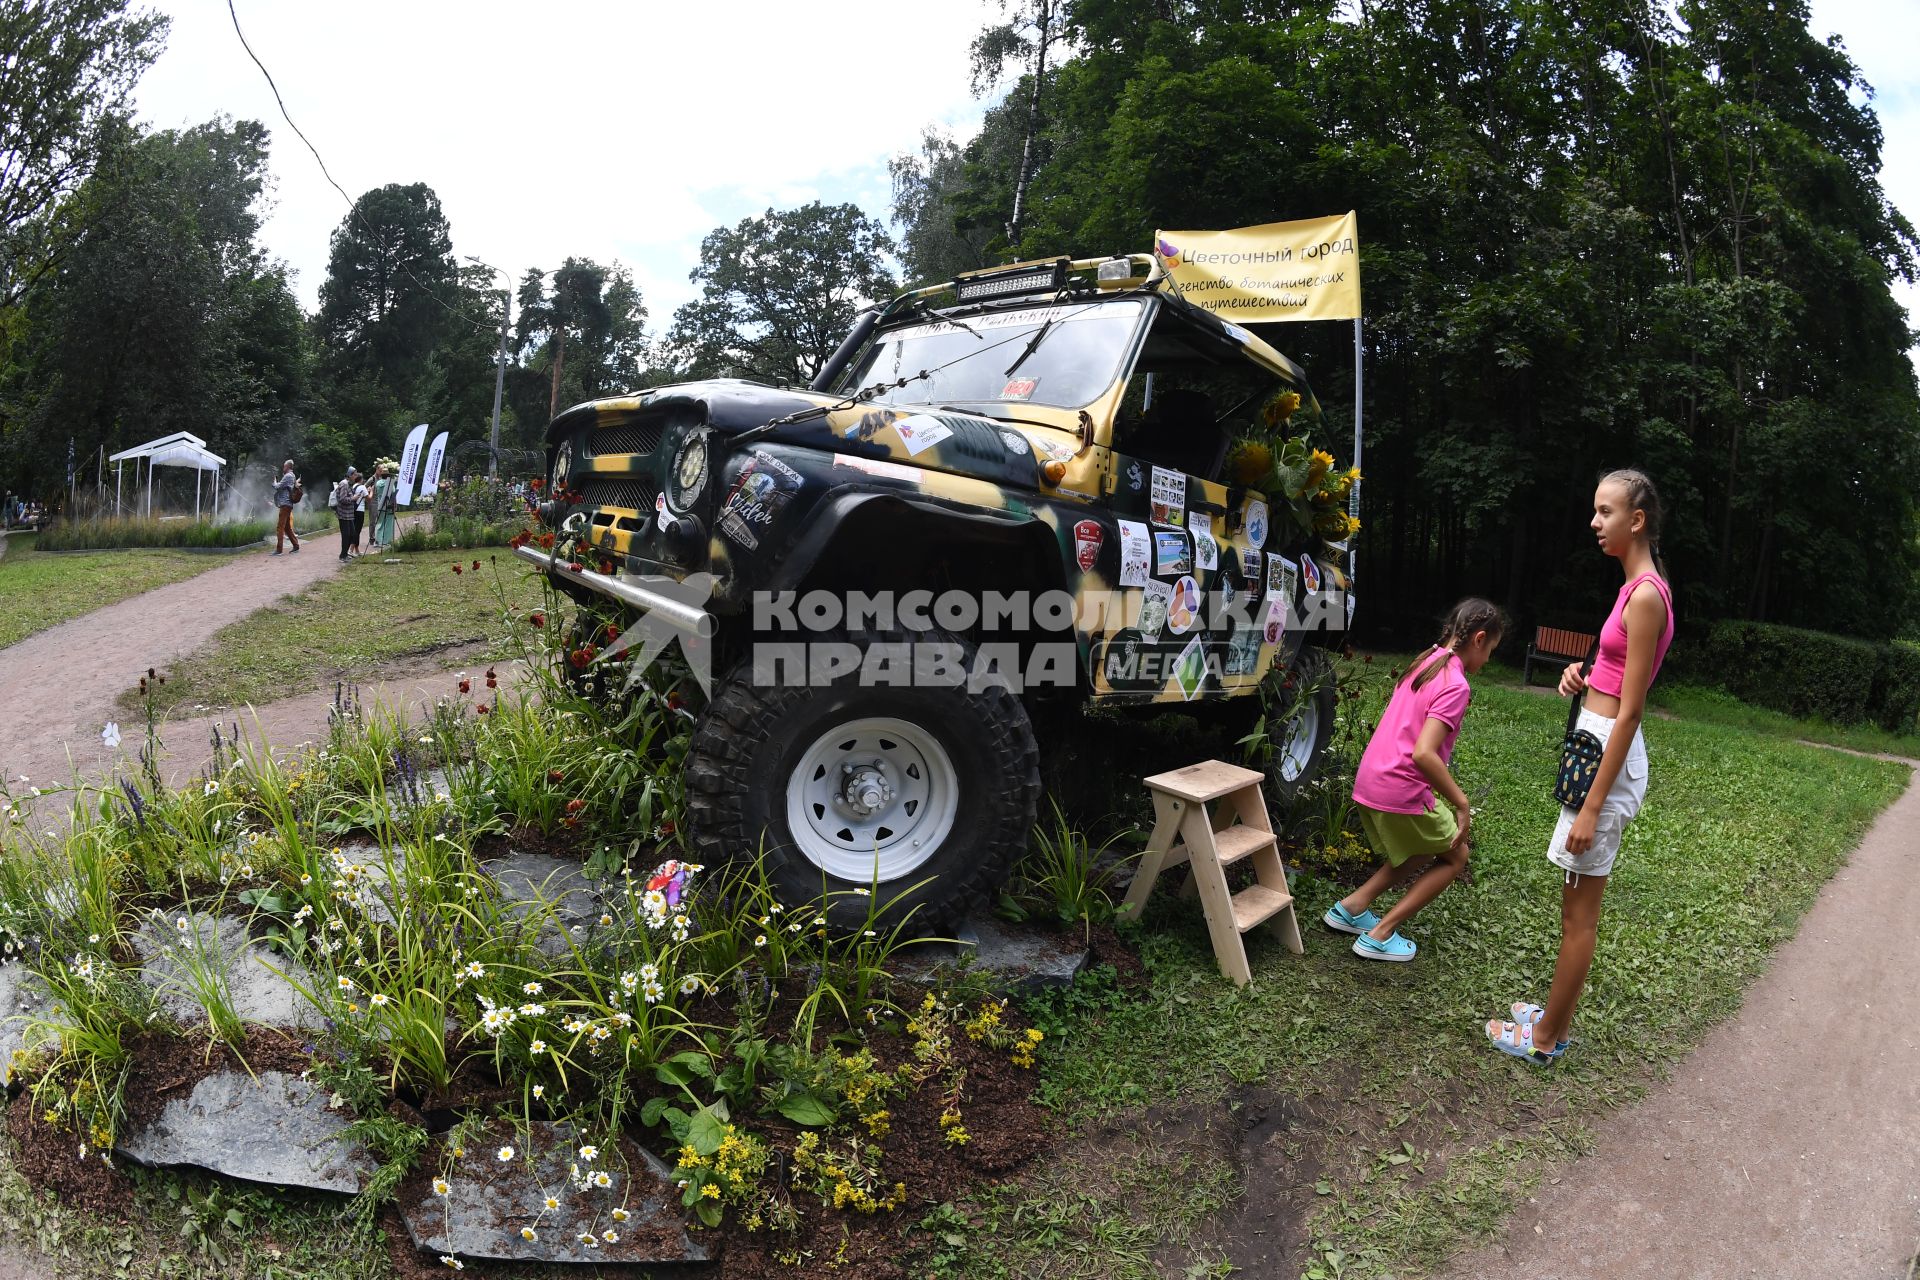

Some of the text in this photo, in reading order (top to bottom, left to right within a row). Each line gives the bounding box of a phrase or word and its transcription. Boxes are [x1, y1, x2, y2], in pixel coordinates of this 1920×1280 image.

[1182, 237, 1354, 265] Цветочный город
[1240, 271, 1344, 289] ботанических
[1201, 293, 1308, 314] путешествий
